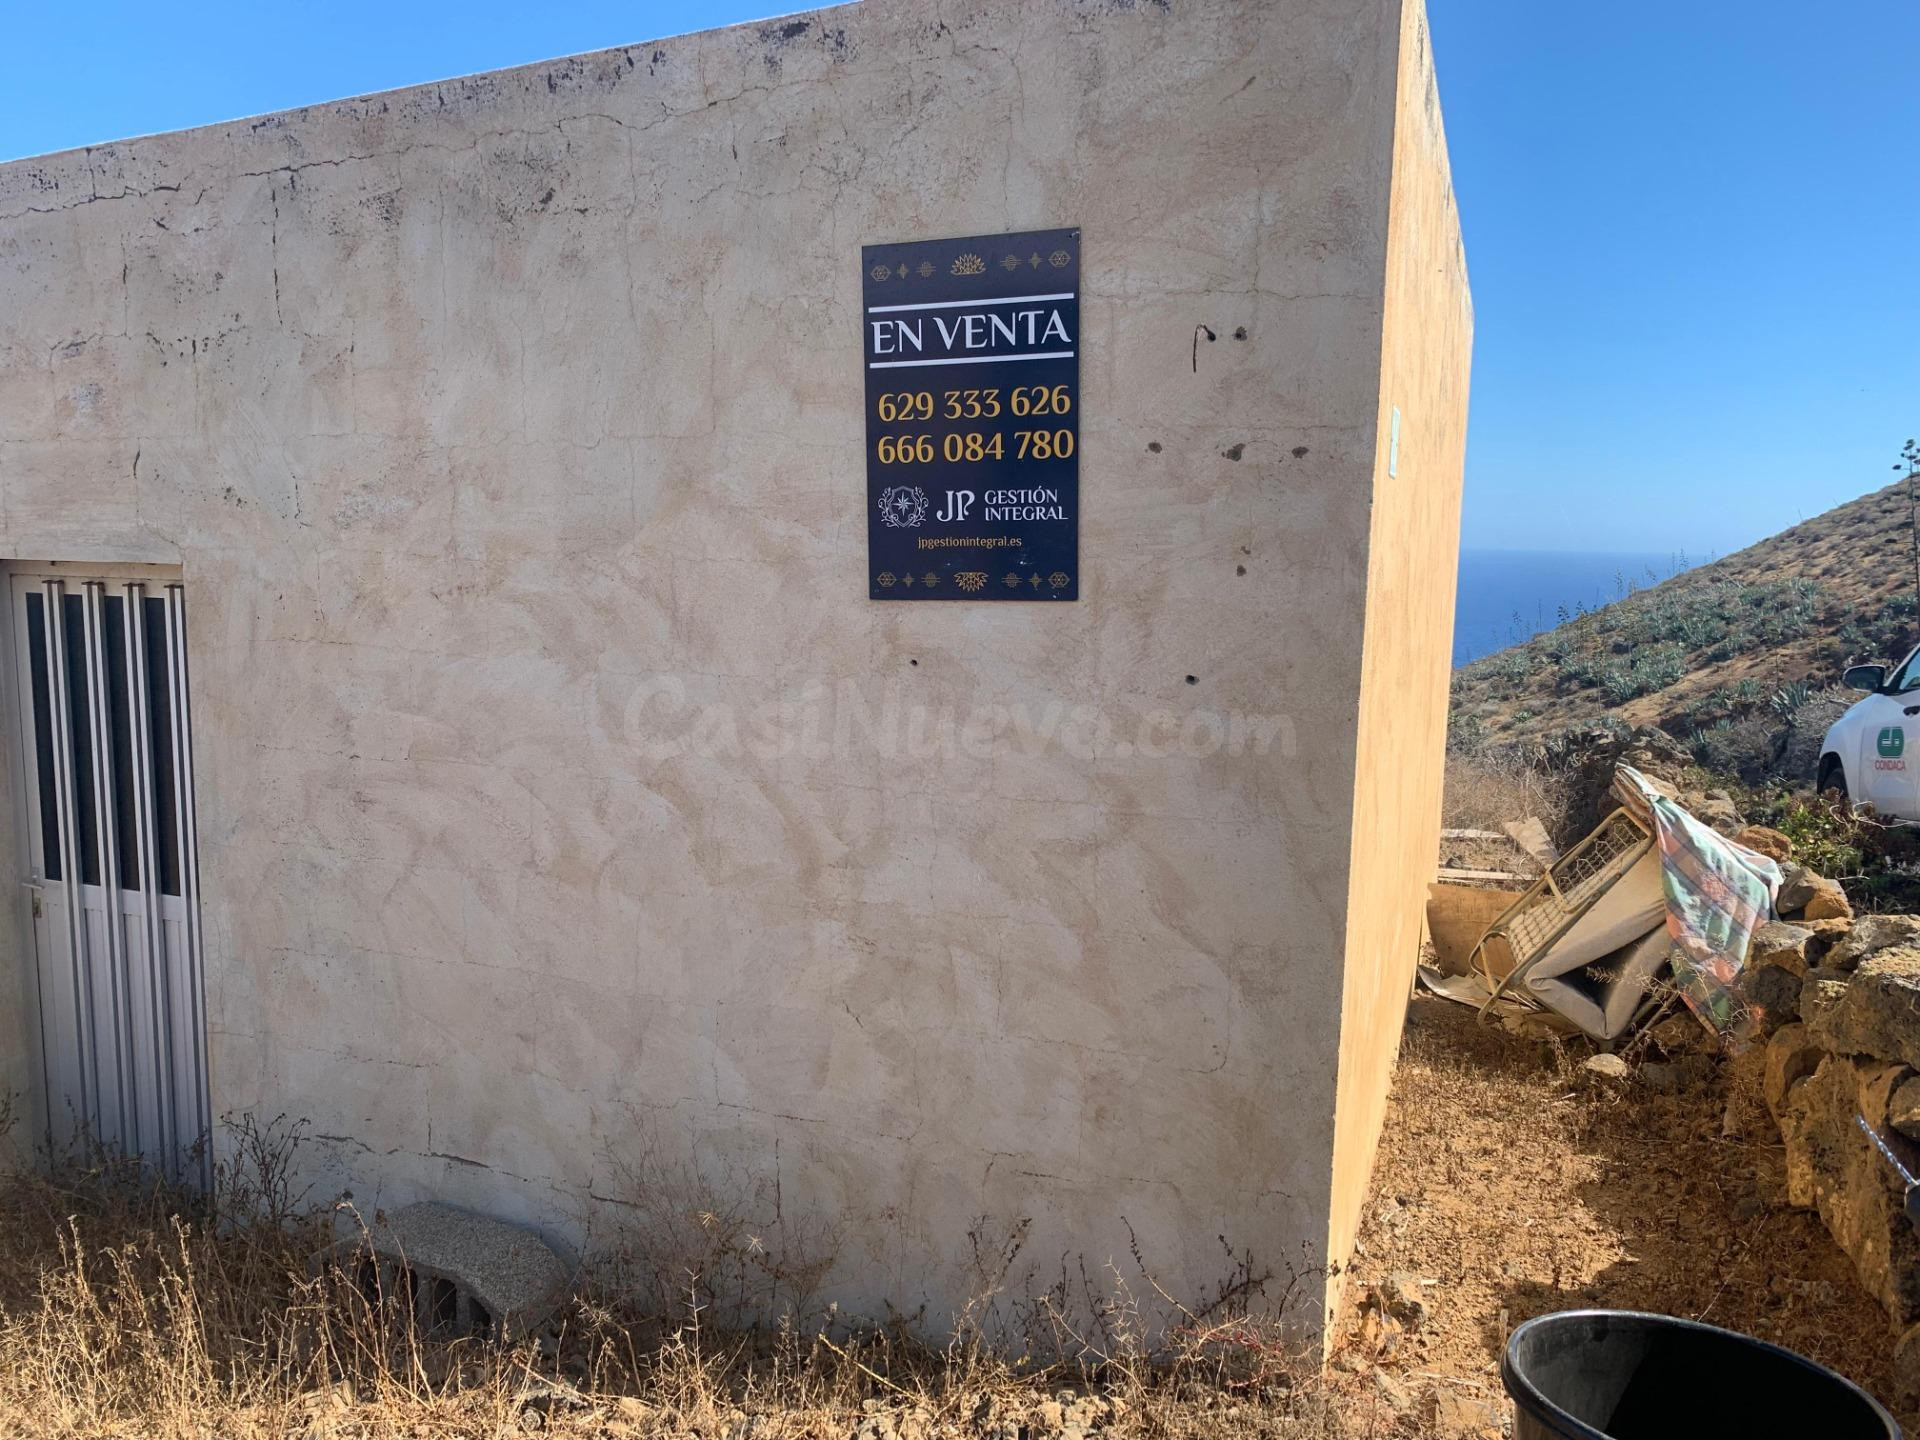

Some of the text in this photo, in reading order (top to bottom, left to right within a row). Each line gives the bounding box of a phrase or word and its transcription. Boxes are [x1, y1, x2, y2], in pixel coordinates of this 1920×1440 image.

[870, 309, 1072, 354] EN VENTA
[878, 384, 1071, 422] 629 333 626
[877, 428, 1075, 464] 666 084 780
[936, 489, 976, 522] JP
[984, 485, 1058, 505] GESTIÓN
[984, 504, 1069, 521] INTEGRAL
[918, 535, 1022, 549] jpgestionintegral.es
[1874, 760, 1906, 771] CONDACA
